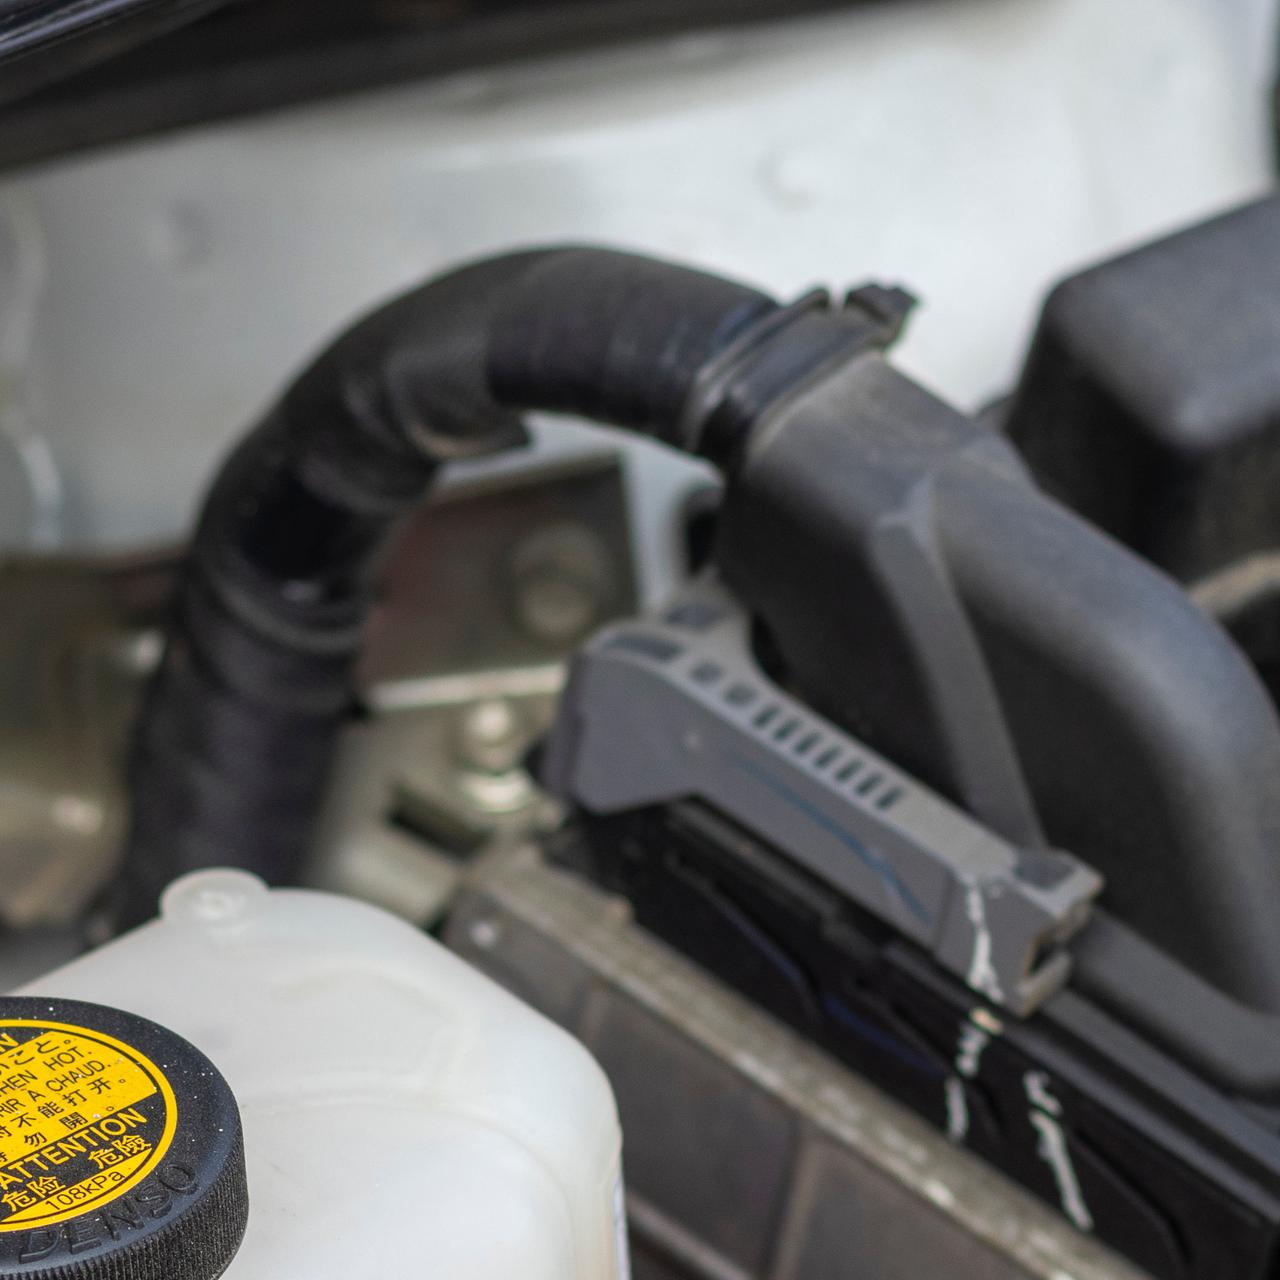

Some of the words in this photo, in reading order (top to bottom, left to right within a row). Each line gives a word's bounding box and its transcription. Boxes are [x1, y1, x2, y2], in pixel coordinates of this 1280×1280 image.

[43, 1046, 92, 1072] HOT.
[45, 1060, 112, 1093] CHAUD.
[88, 1134, 153, 1170] 危險
[1, 1175, 66, 1212] 危险
[44, 1169, 126, 1212] 108kPa
[17, 1162, 200, 1264] DENSO
